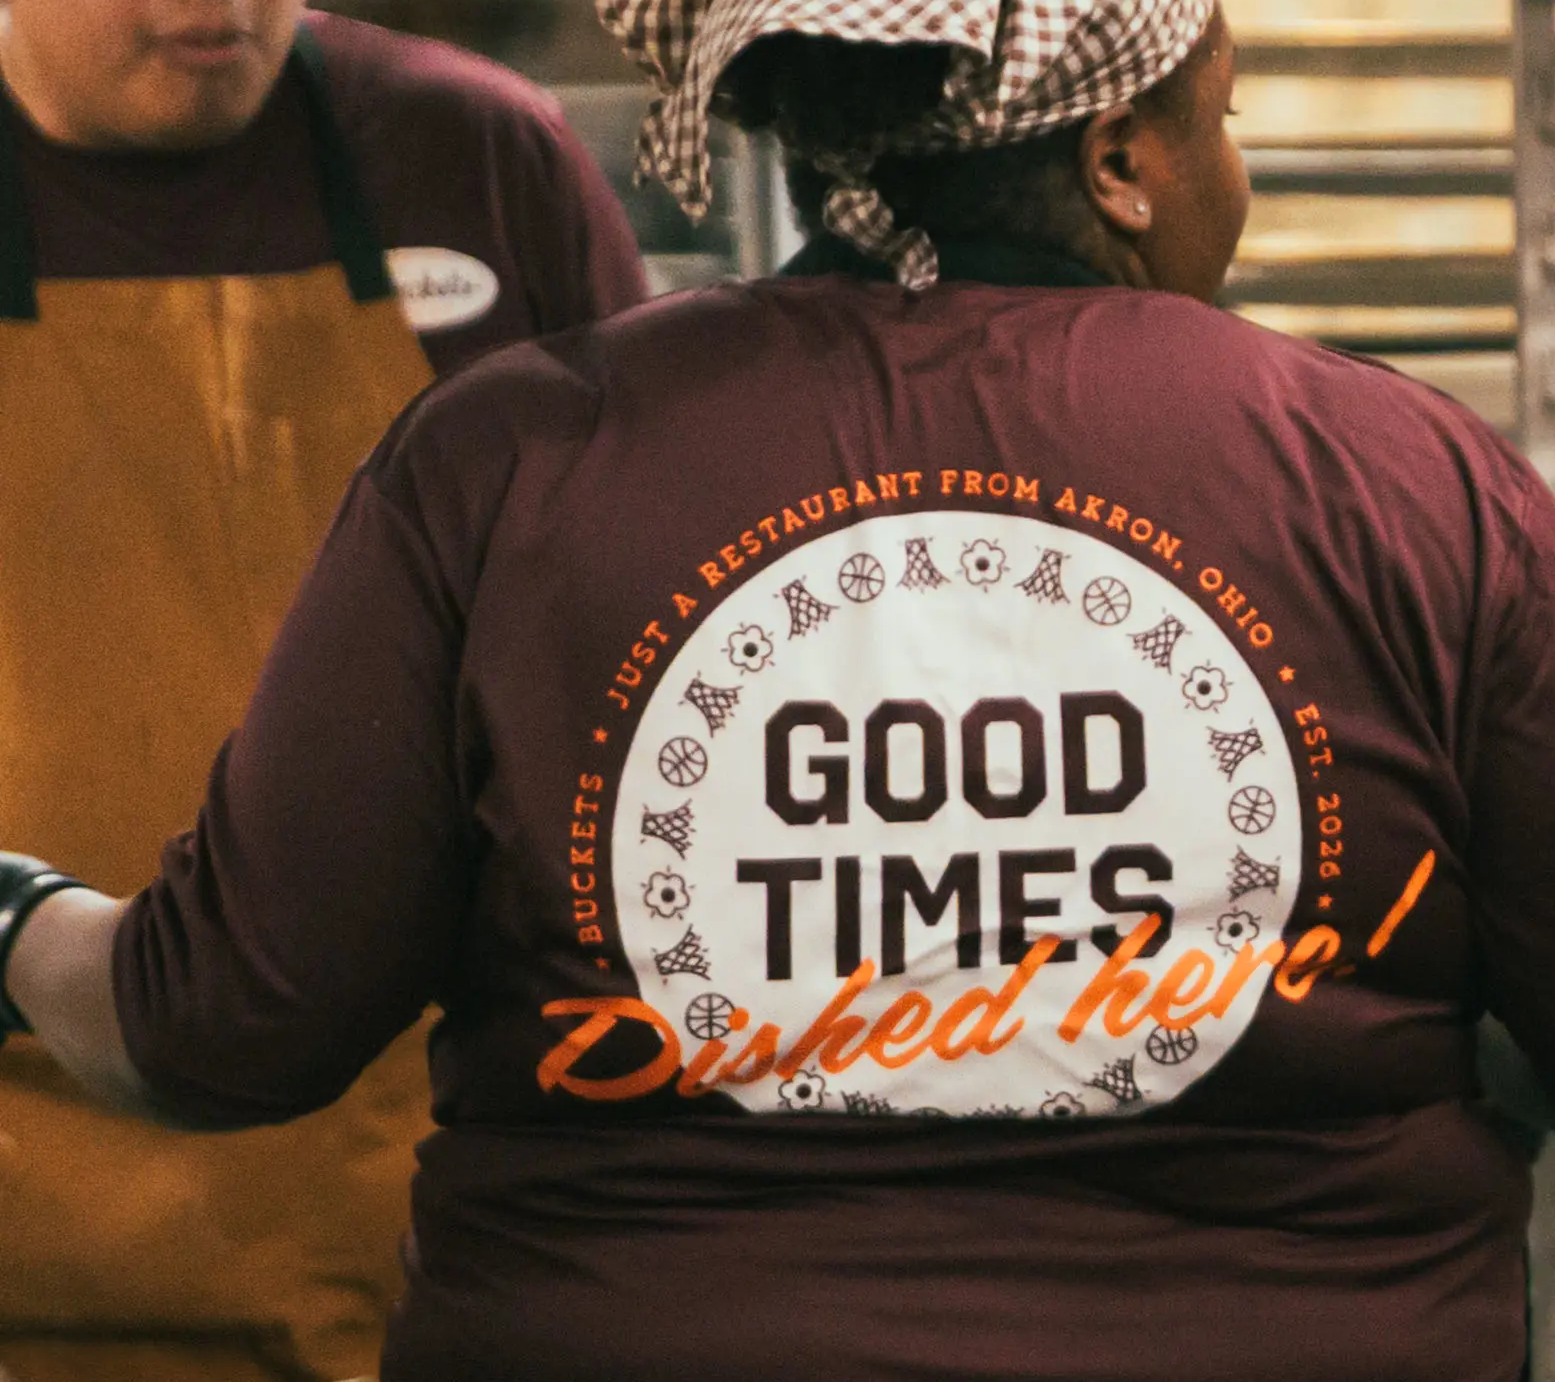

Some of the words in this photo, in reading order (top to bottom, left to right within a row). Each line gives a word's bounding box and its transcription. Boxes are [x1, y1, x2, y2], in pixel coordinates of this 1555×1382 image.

[607, 620, 670, 710] JUST
[672, 592, 698, 619] A
[697, 470, 923, 589] RESTAURANT
[939, 468, 1041, 505] FROM
[1053, 486, 1185, 574] AKRON,
[1197, 565, 1275, 649] OHIO
[764, 689, 1148, 826] GOOD
[1293, 702, 1334, 779] EST.
[1316, 792, 1343, 884] 2026
[569, 772, 604, 945] BUCKETS
[736, 843, 1174, 981] TIMES
[537, 937, 1064, 1101] Dished
[1057, 850, 1436, 1046] here!
